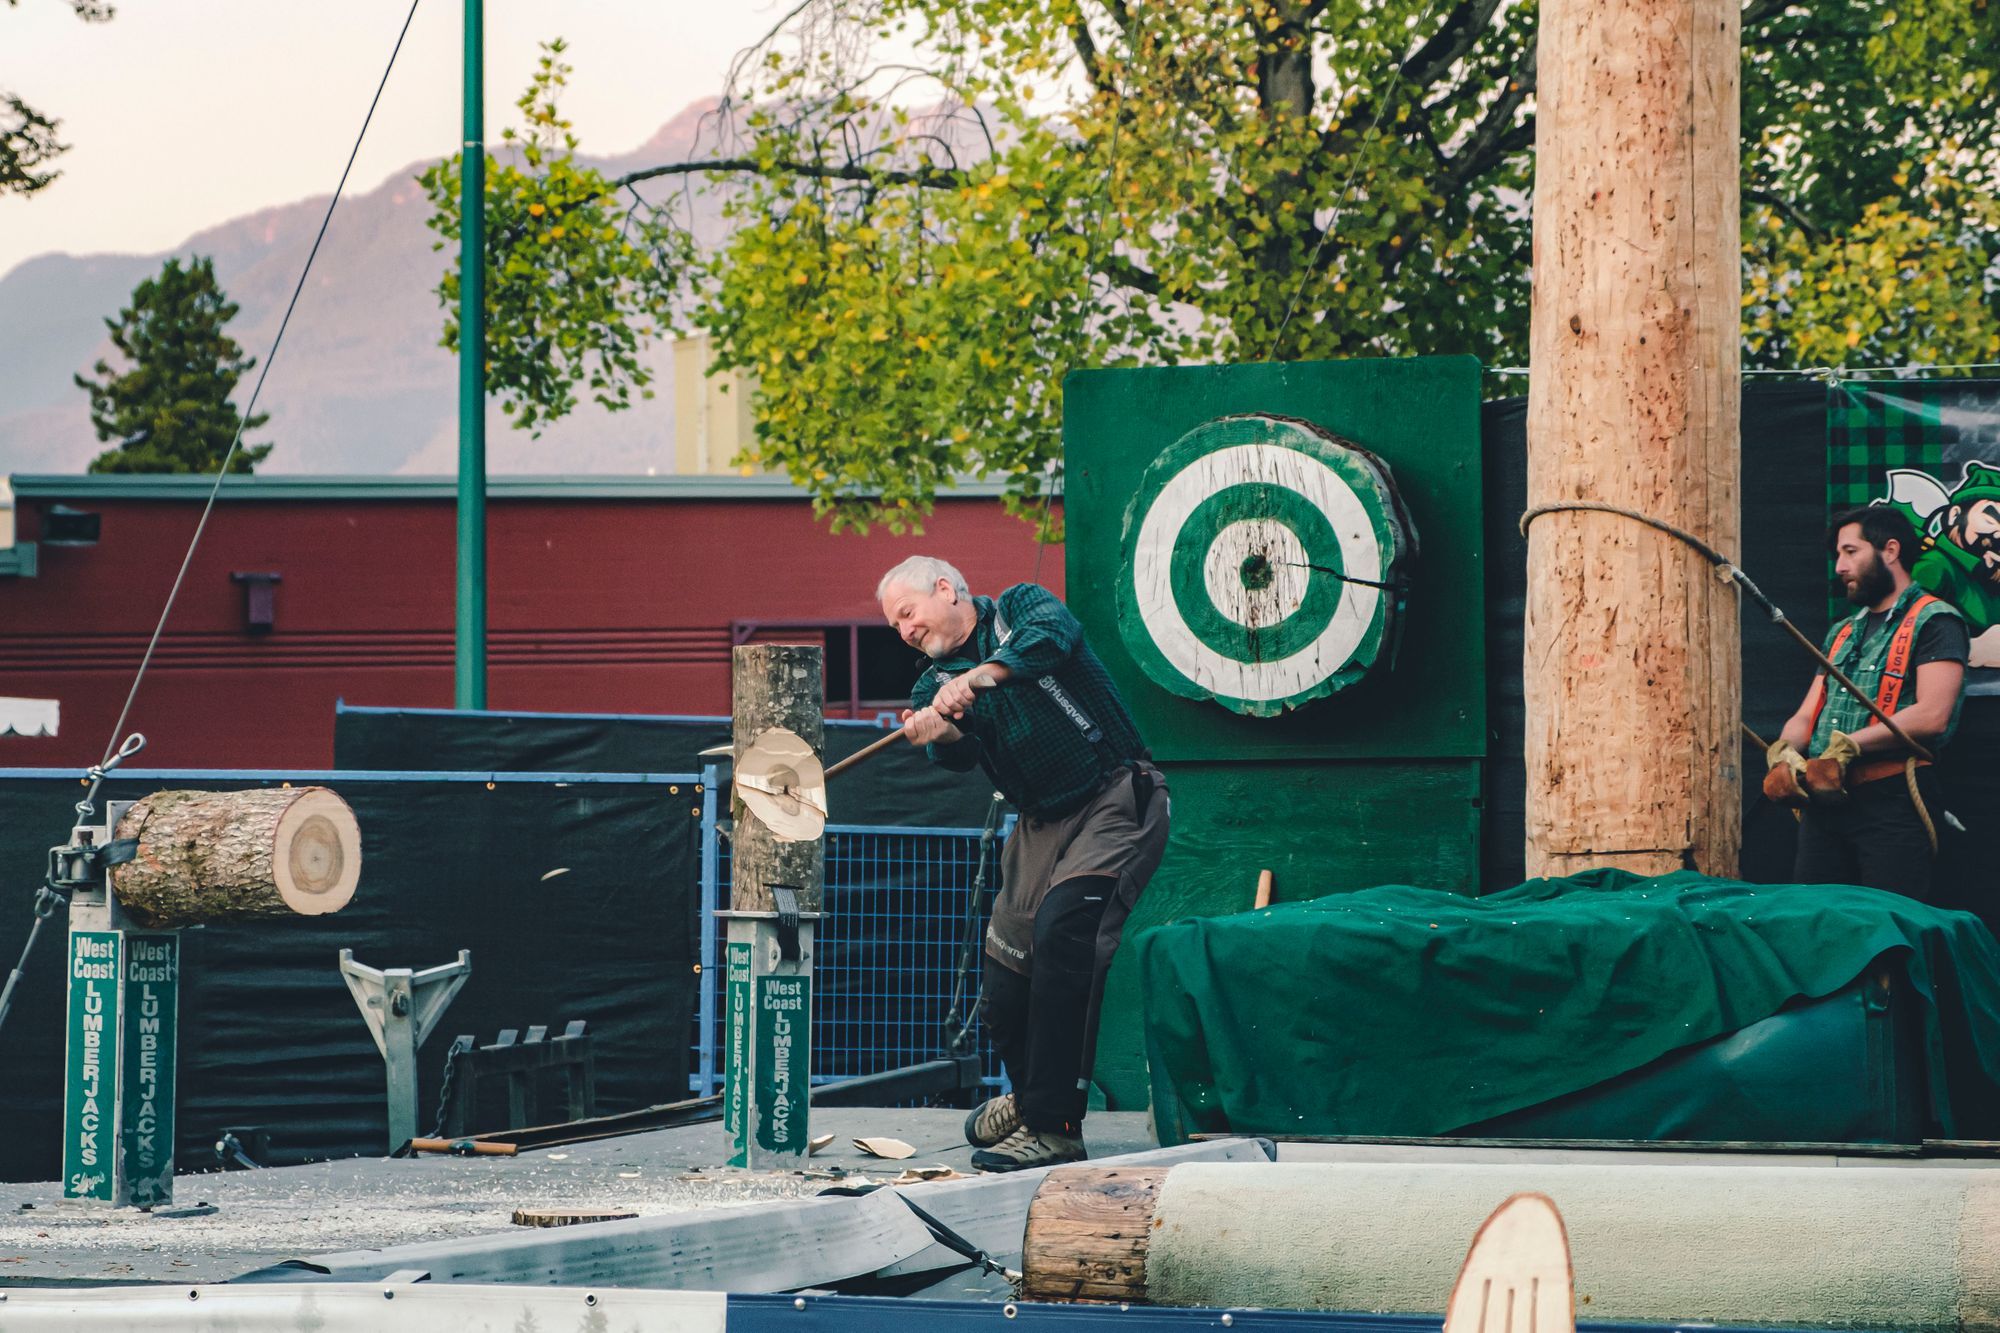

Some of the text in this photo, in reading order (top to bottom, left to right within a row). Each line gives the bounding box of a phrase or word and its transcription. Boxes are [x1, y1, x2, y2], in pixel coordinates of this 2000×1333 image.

[76, 937, 114, 958] West
[132, 941, 171, 962] West
[731, 946, 749, 965] West
[74, 958, 115, 979] Coast
[130, 963, 172, 982] Coast
[730, 966, 749, 983] Coast
[765, 980, 801, 995] West
[764, 996, 802, 1010] Coast
[81, 981, 103, 1166] LUMBERJACKS
[138, 984, 160, 1169] LUMBERJACKS
[773, 1011, 791, 1143] LUMBERJACKS
